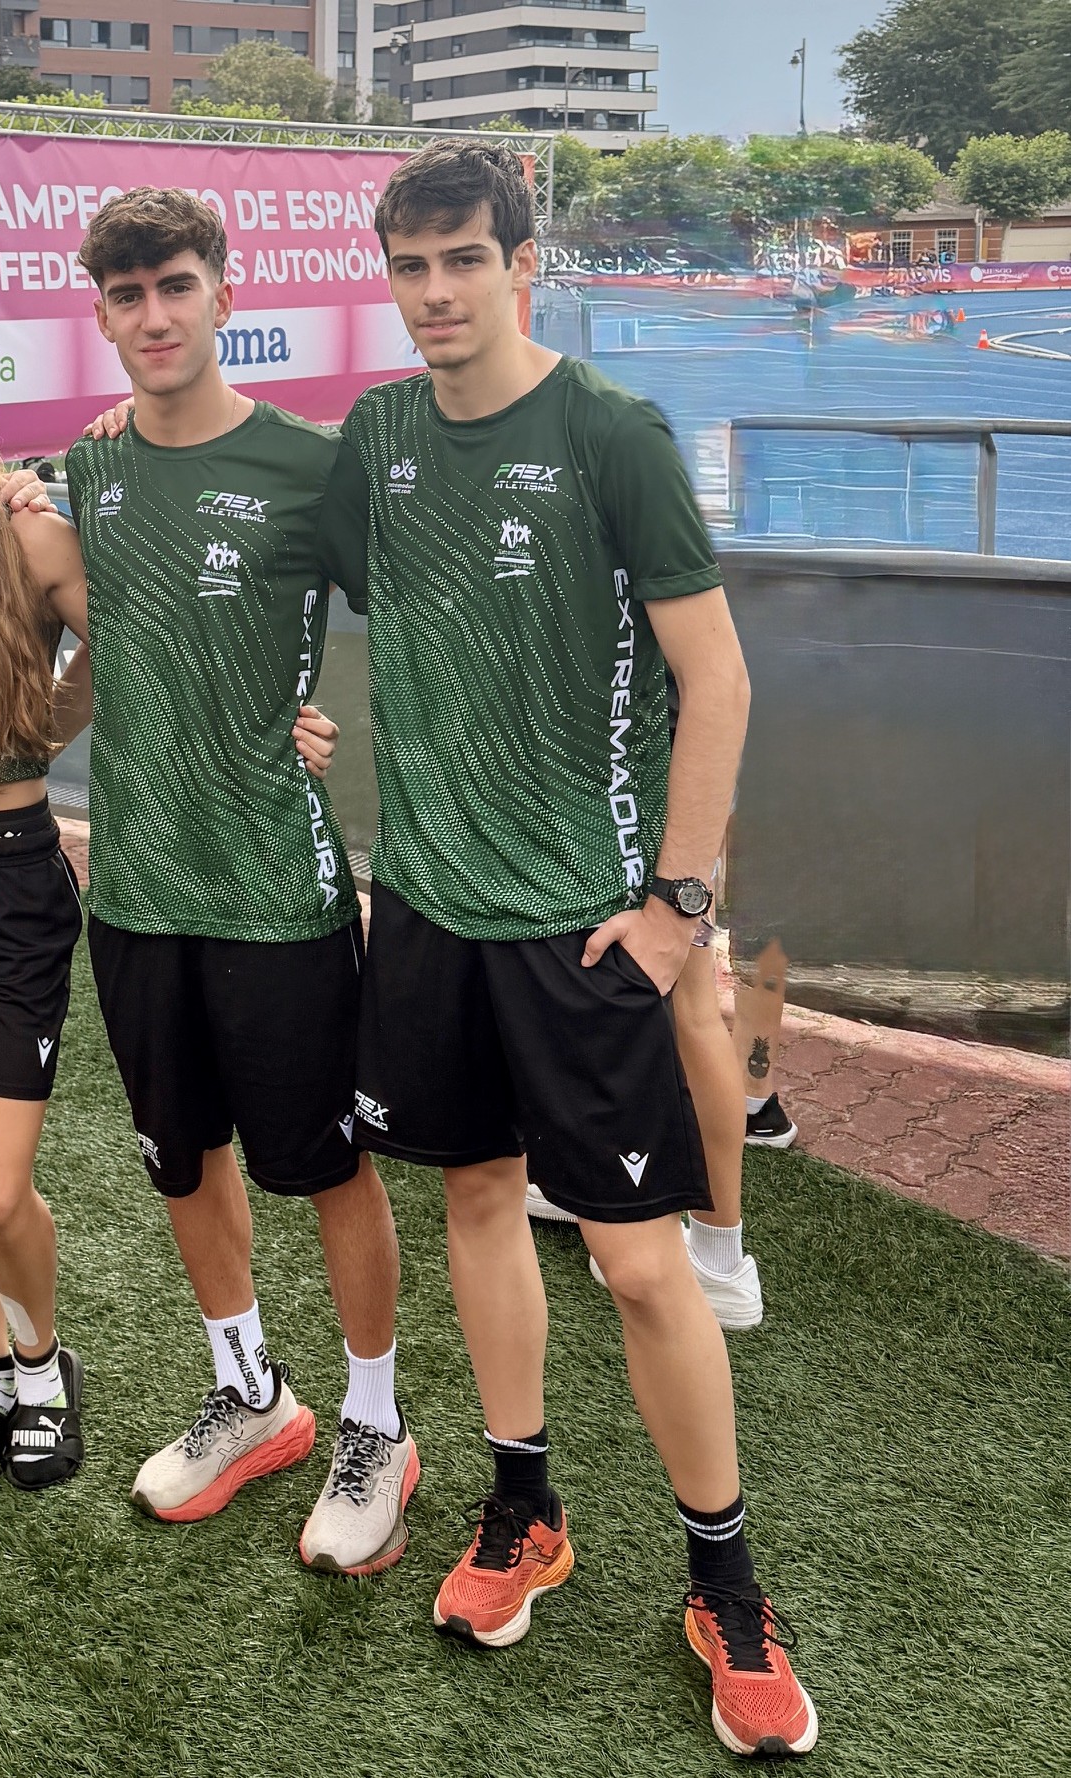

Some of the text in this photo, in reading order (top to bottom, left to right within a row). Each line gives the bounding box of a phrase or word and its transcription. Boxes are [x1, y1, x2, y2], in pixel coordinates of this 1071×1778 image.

[234, 189, 280, 230] DE
[493, 463, 563, 482] FAEX
[493, 480, 558, 493] ATLETISMO
[196, 490, 271, 513] FAEX
[196, 505, 267, 523] ATLETISMO
[229, 1336, 261, 1405] FOOTBALLSOCKS
[11, 1430, 57, 1448] PUMA
